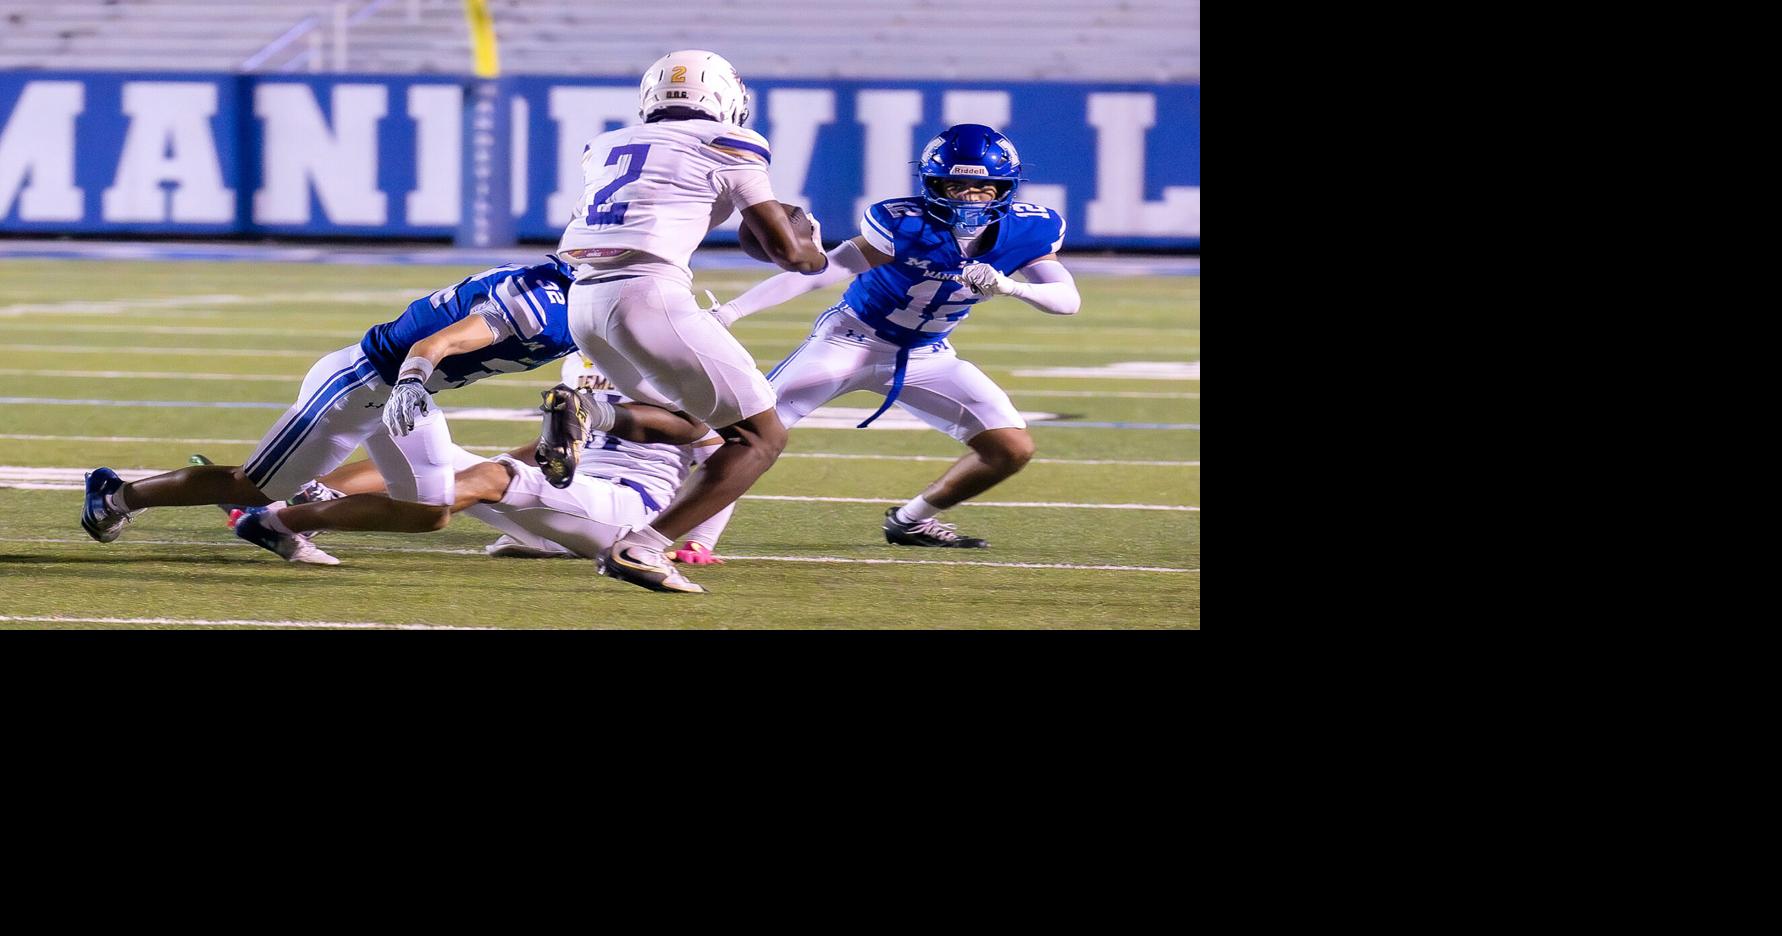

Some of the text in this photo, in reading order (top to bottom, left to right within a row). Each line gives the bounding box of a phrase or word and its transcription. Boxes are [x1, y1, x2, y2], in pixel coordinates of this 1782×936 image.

[670, 65, 687, 83] 2
[954, 167, 985, 175] Riddell
[586, 143, 652, 226] 2
[1010, 202, 1051, 220] 12
[903, 256, 932, 270] M
[885, 279, 985, 333] 12
